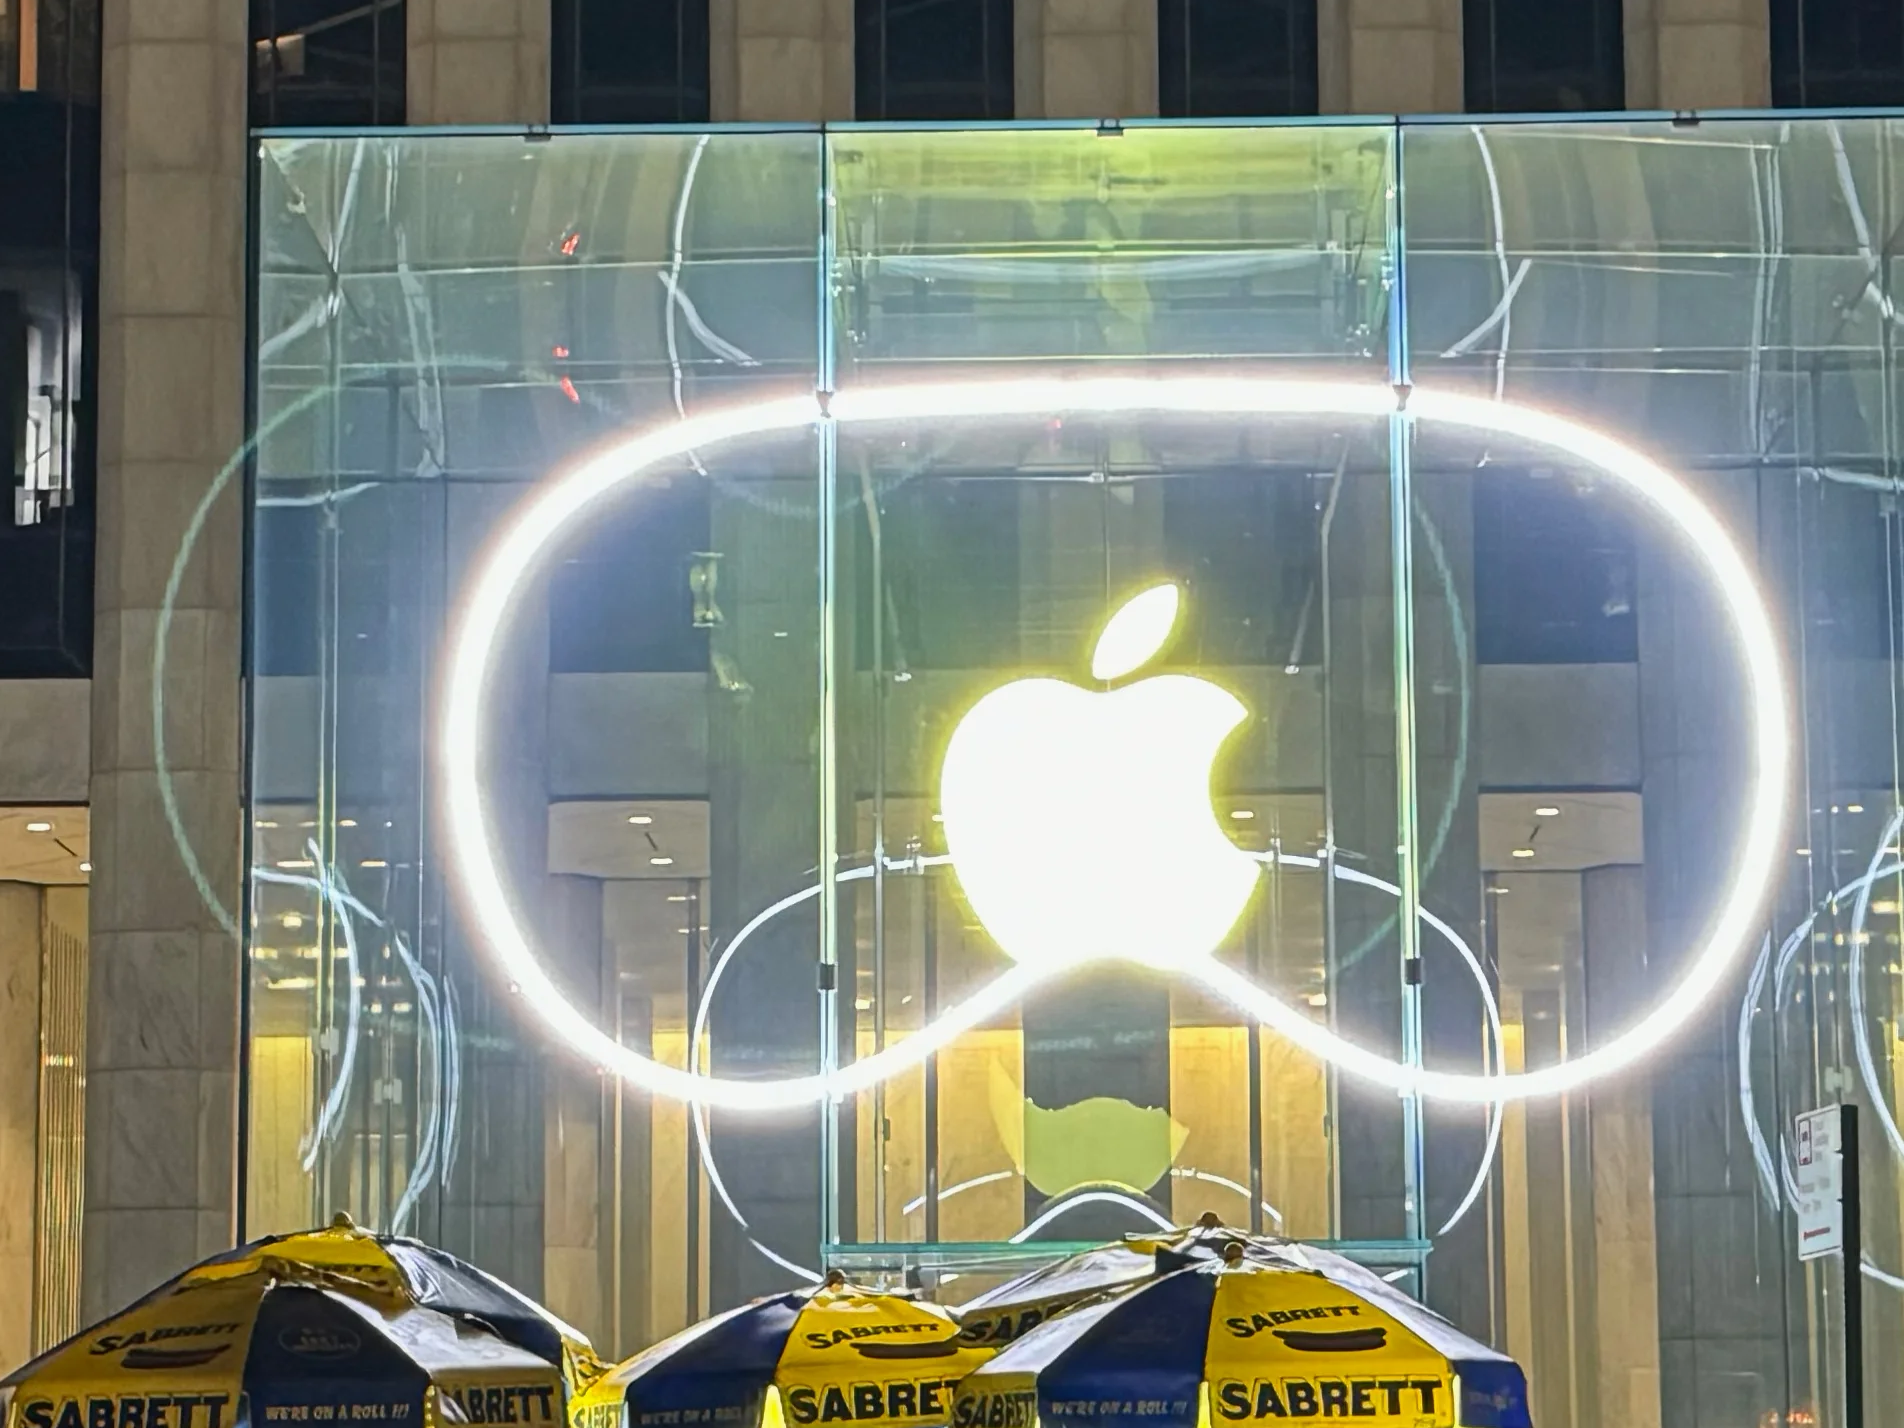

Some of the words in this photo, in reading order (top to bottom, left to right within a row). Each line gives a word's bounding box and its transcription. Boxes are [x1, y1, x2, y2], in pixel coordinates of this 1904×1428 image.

[804, 1321, 940, 1350] SABRETT
[1224, 1304, 1360, 1339] SABRETT
[89, 1323, 240, 1356] SABRETT
[1218, 1379, 1443, 1420] SABRETT
